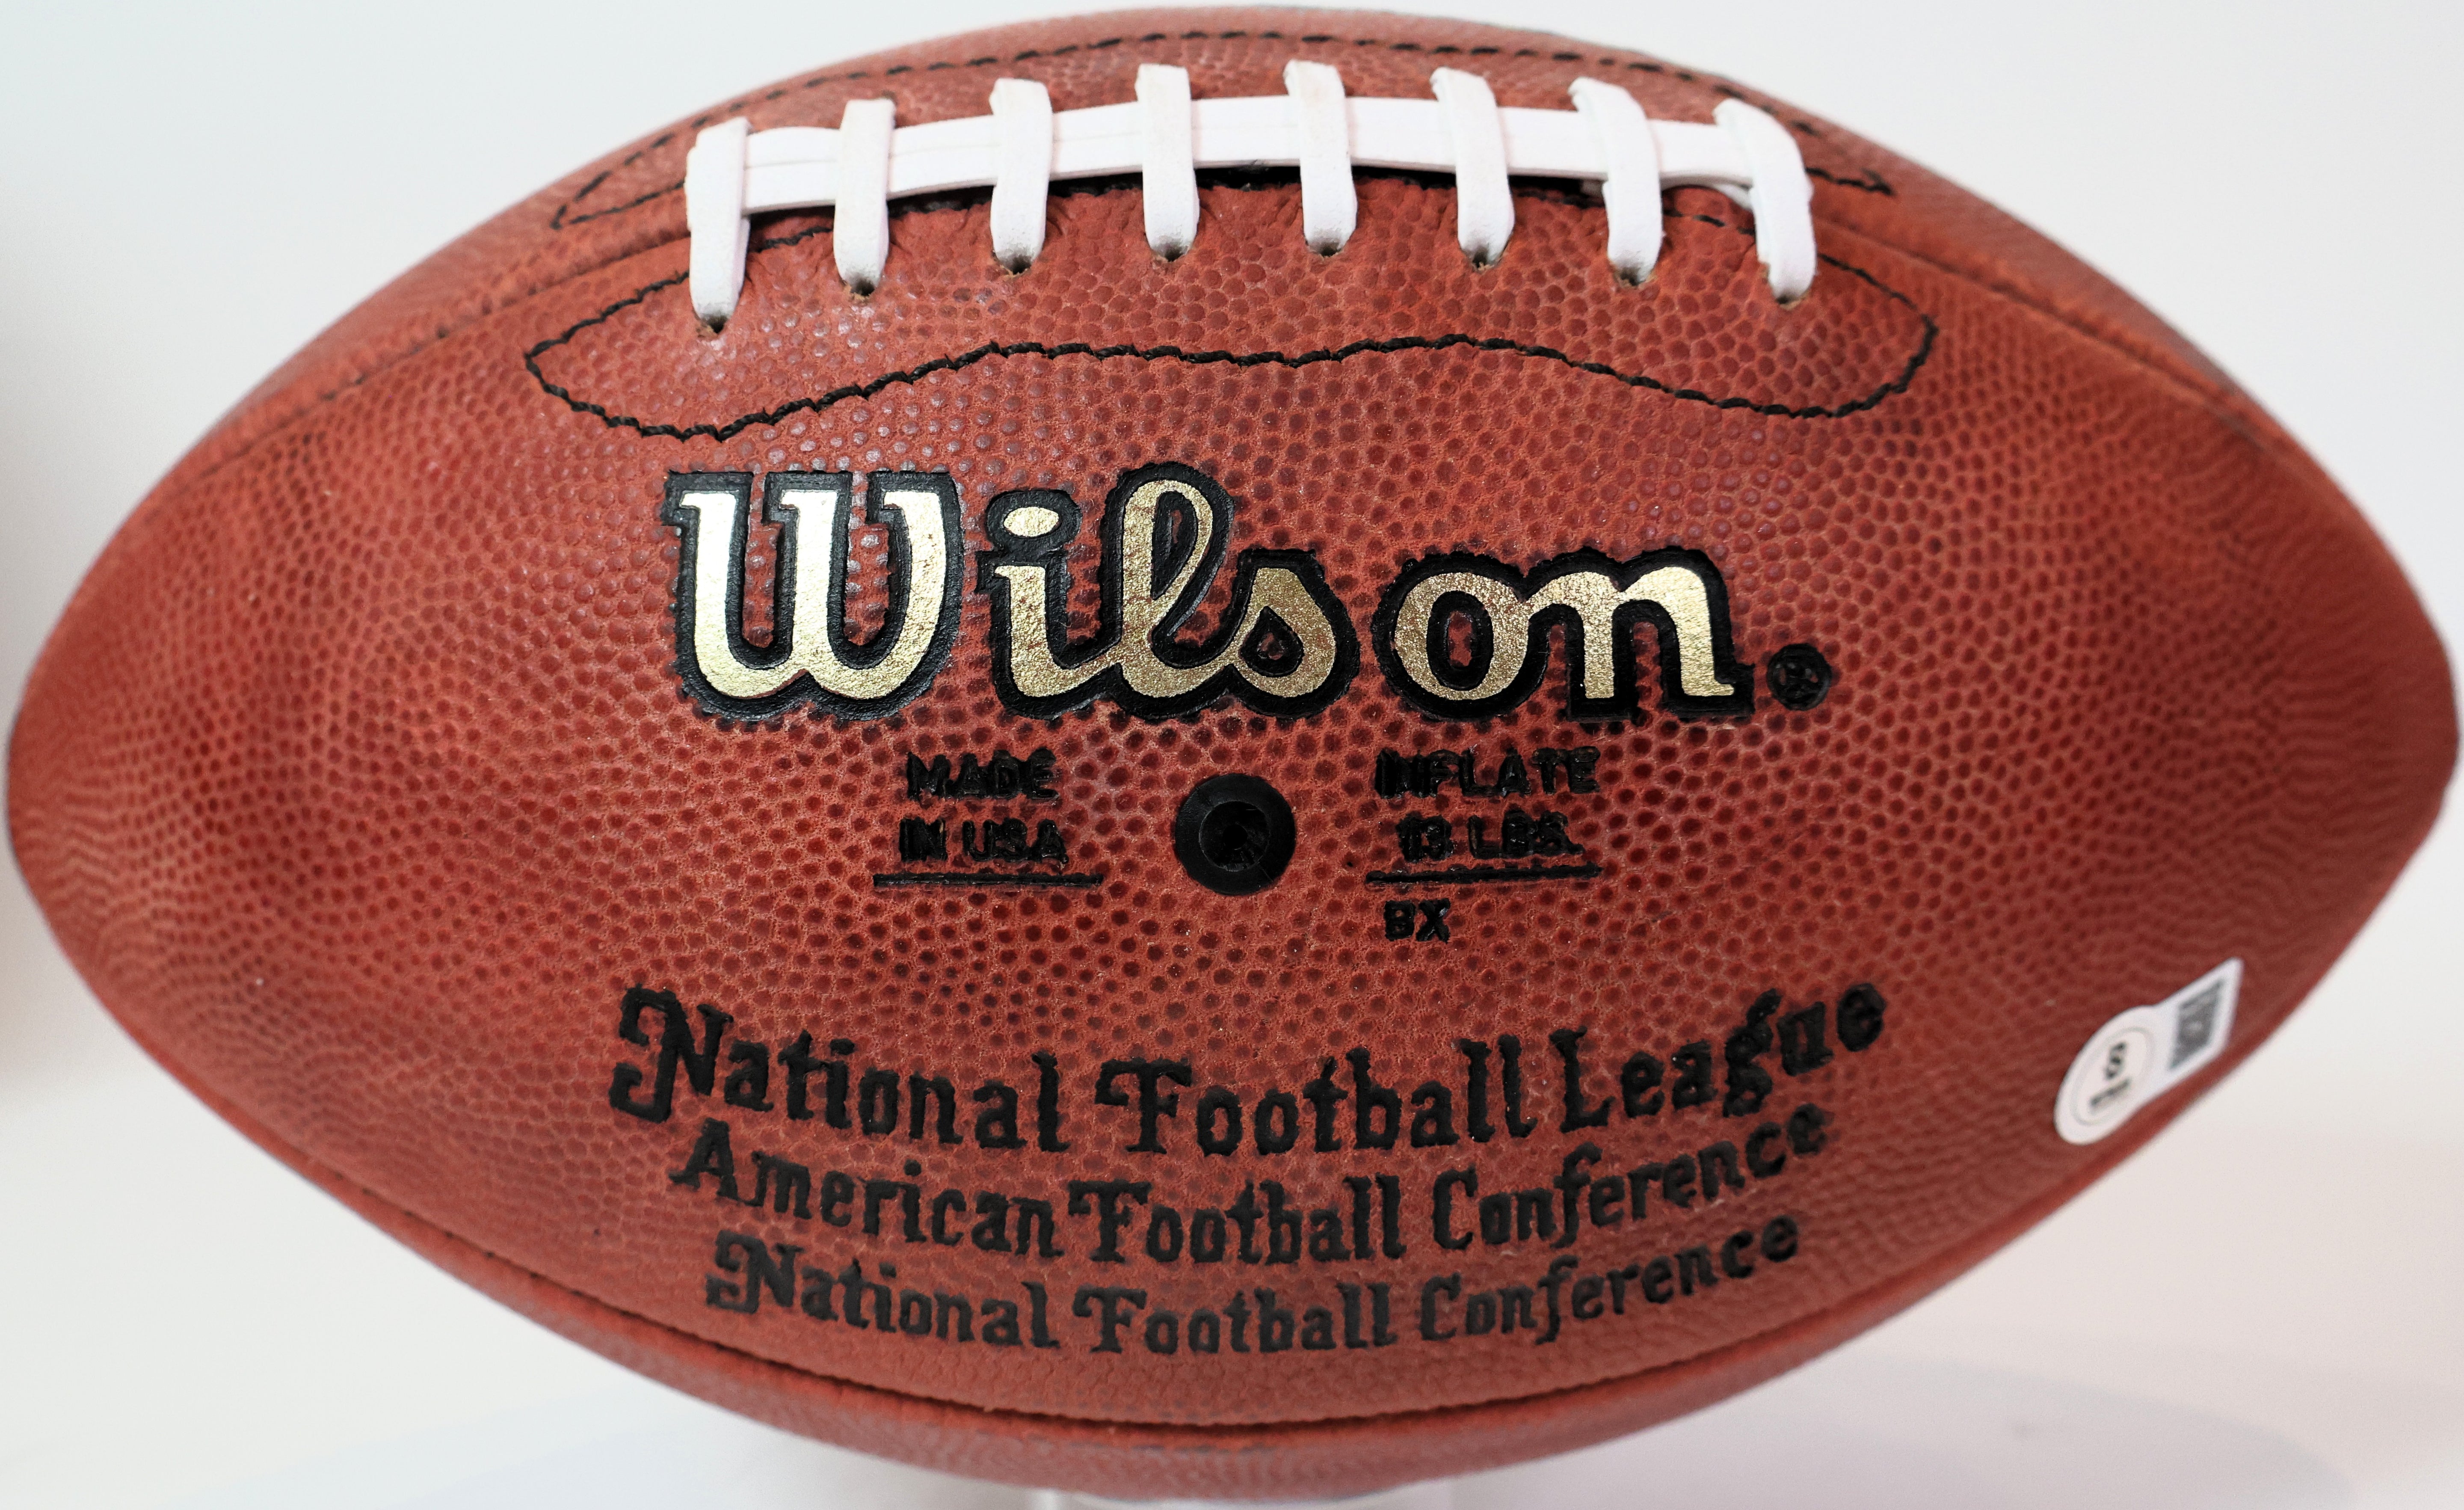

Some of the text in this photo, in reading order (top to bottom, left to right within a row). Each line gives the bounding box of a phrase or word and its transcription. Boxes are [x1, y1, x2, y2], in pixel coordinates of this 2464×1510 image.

[664, 464, 1756, 724] Wilson
[900, 817, 947, 862] IN
[906, 748, 1059, 801] MADE
[1396, 812, 1454, 863] 13
[607, 982, 1886, 1157] National Football League
[668, 1102, 1831, 1264] American Football Conference
[704, 1214, 1799, 1356] National Football Conference
